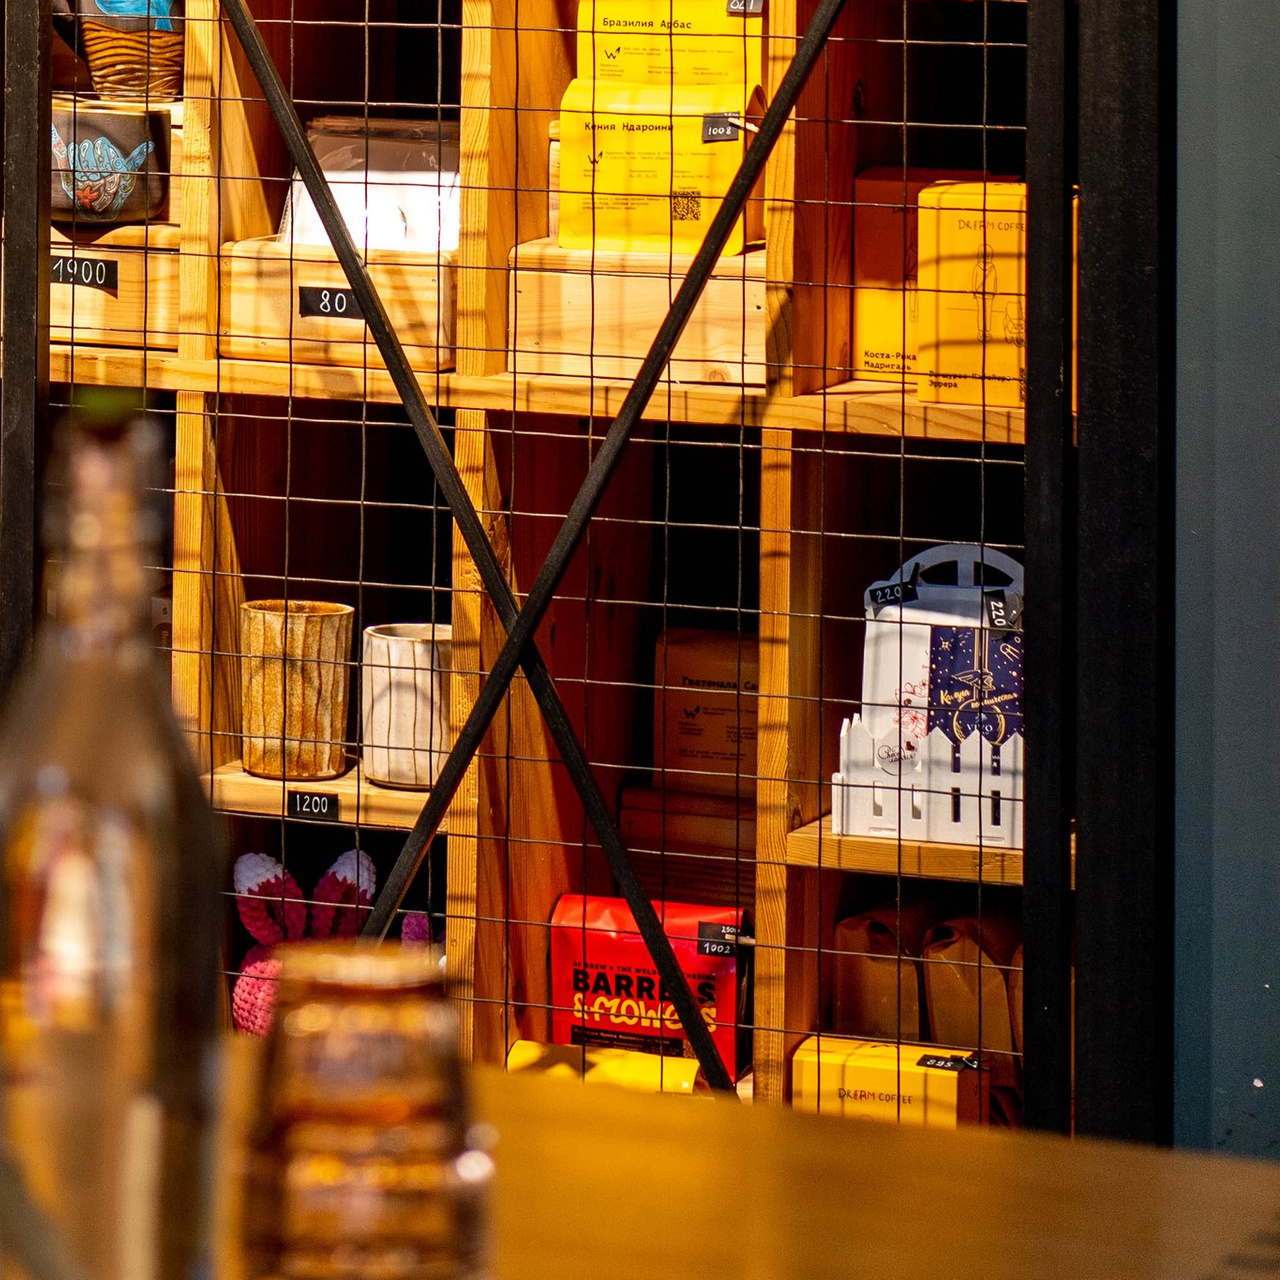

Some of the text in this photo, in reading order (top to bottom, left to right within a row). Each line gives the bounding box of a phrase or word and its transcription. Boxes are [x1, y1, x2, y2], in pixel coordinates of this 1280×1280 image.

[602, 17, 692, 30] Бразилия Арбас
[584, 122, 616, 131] Кения
[708, 126, 732, 136] 1008
[52, 258, 106, 284] 1900
[319, 290, 347, 313] 80
[876, 586, 903, 604] 220
[990, 600, 1007, 627] 220
[296, 794, 328, 813] 1200
[703, 942, 731, 954] 1002
[838, 1087, 876, 1101] DREAM
